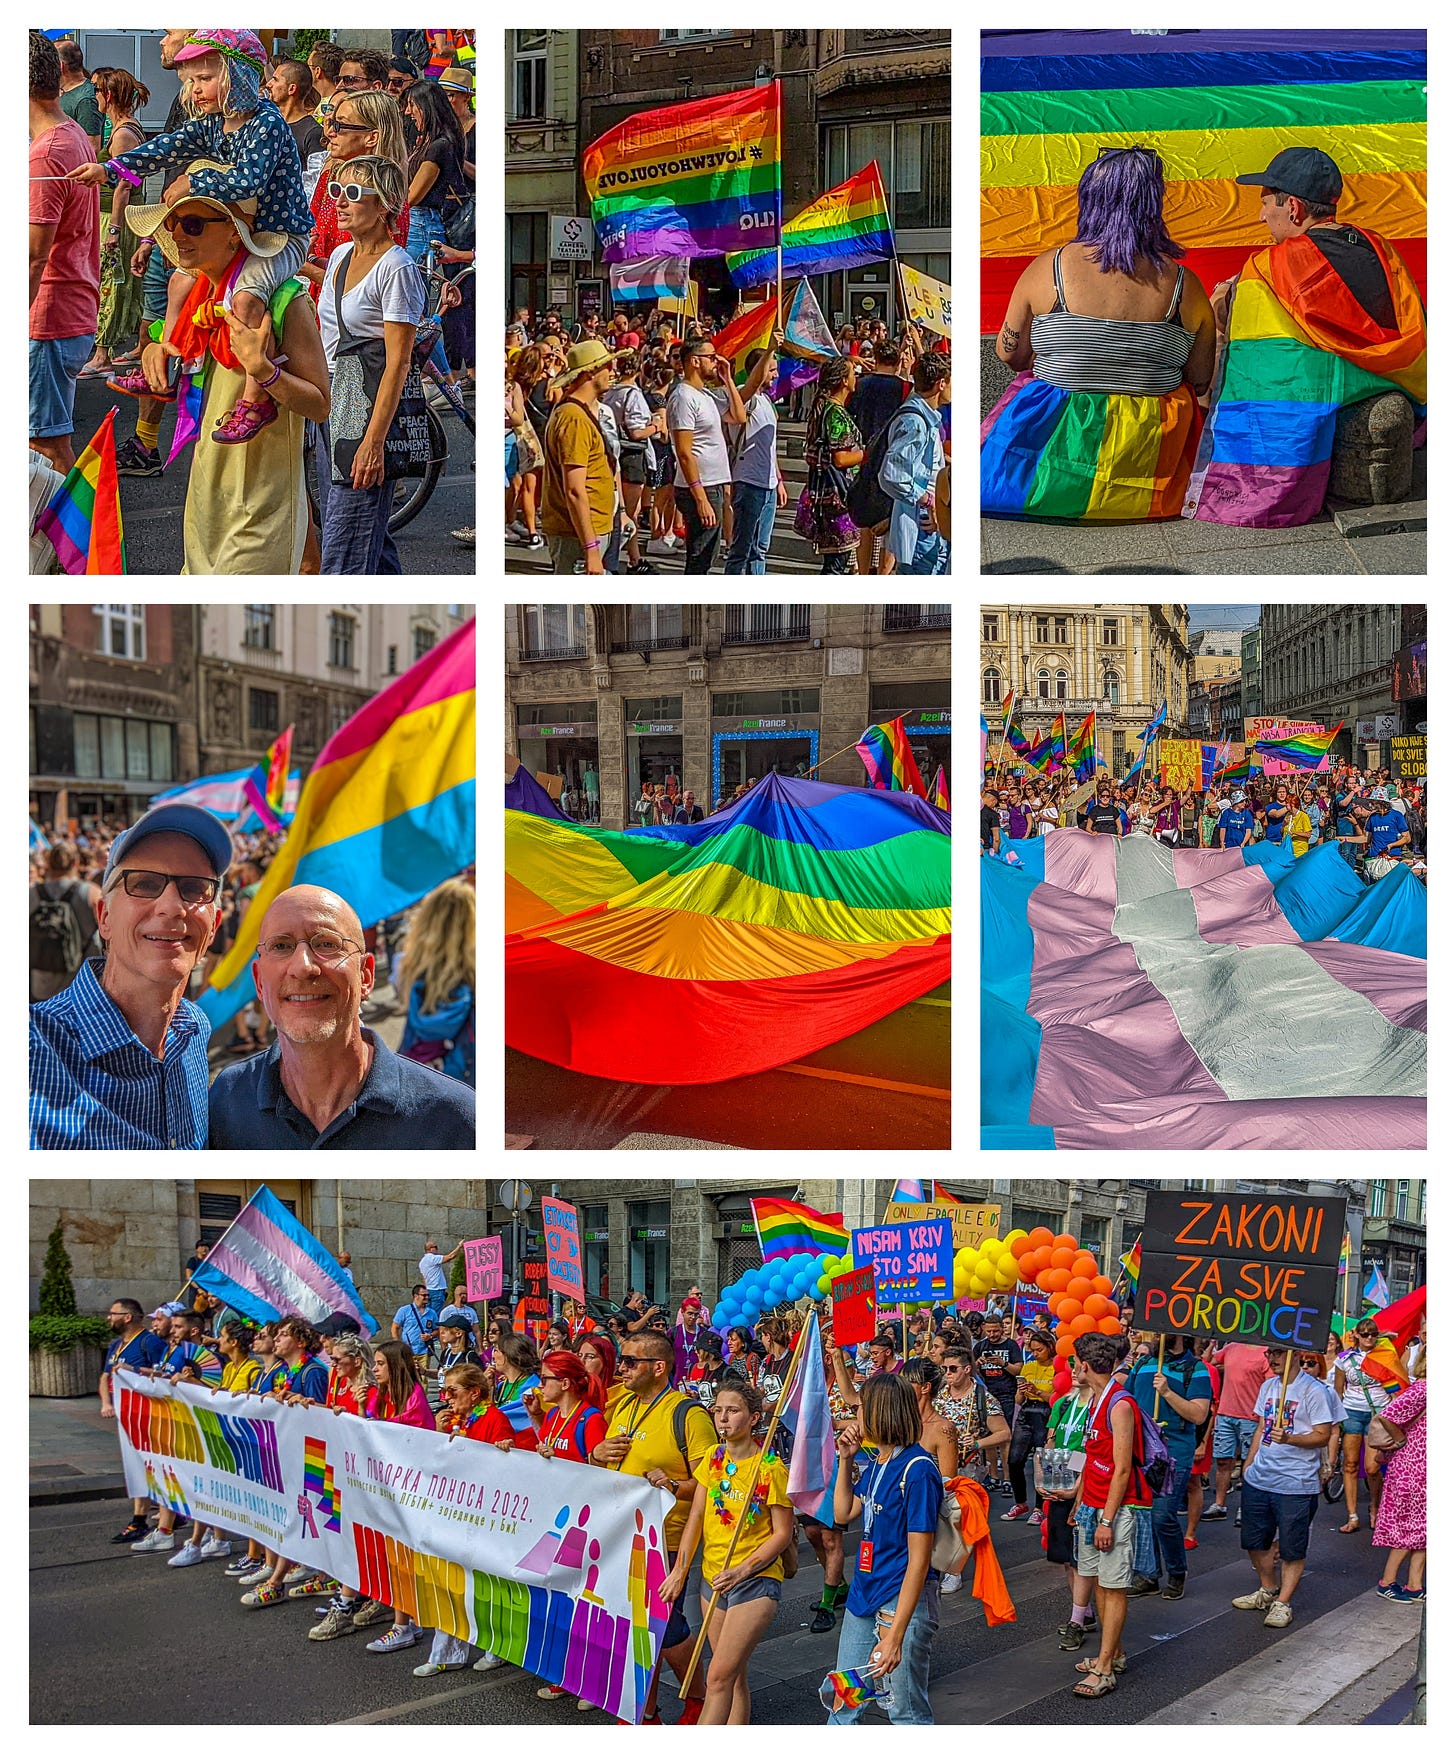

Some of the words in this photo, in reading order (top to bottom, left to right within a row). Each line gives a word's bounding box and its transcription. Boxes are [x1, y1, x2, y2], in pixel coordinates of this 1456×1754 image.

[386, 439, 431, 452] WOMEN'S
[406, 427, 430, 439] WITH
[409, 451, 431, 463] FACE
[1391, 737, 1408, 747] NIKO
[857, 1229, 902, 1256] NISAM
[908, 1225, 944, 1250] KRIV
[1174, 1201, 1323, 1254] ZAKONI
[466, 1243, 499, 1269] PUSSY
[873, 1254, 901, 1277] ŠTO
[907, 1252, 938, 1274] SAM
[471, 1268, 499, 1295] RIOT
[1171, 1255, 1222, 1294] ZA
[1234, 1263, 1305, 1306] SVE
[1145, 1288, 1319, 1346] PORODICE
[367, 1457, 422, 1493] ПОВОРКА
[427, 1474, 485, 1509] ПОНОСА
[491, 1489, 533, 1523] 2022.
